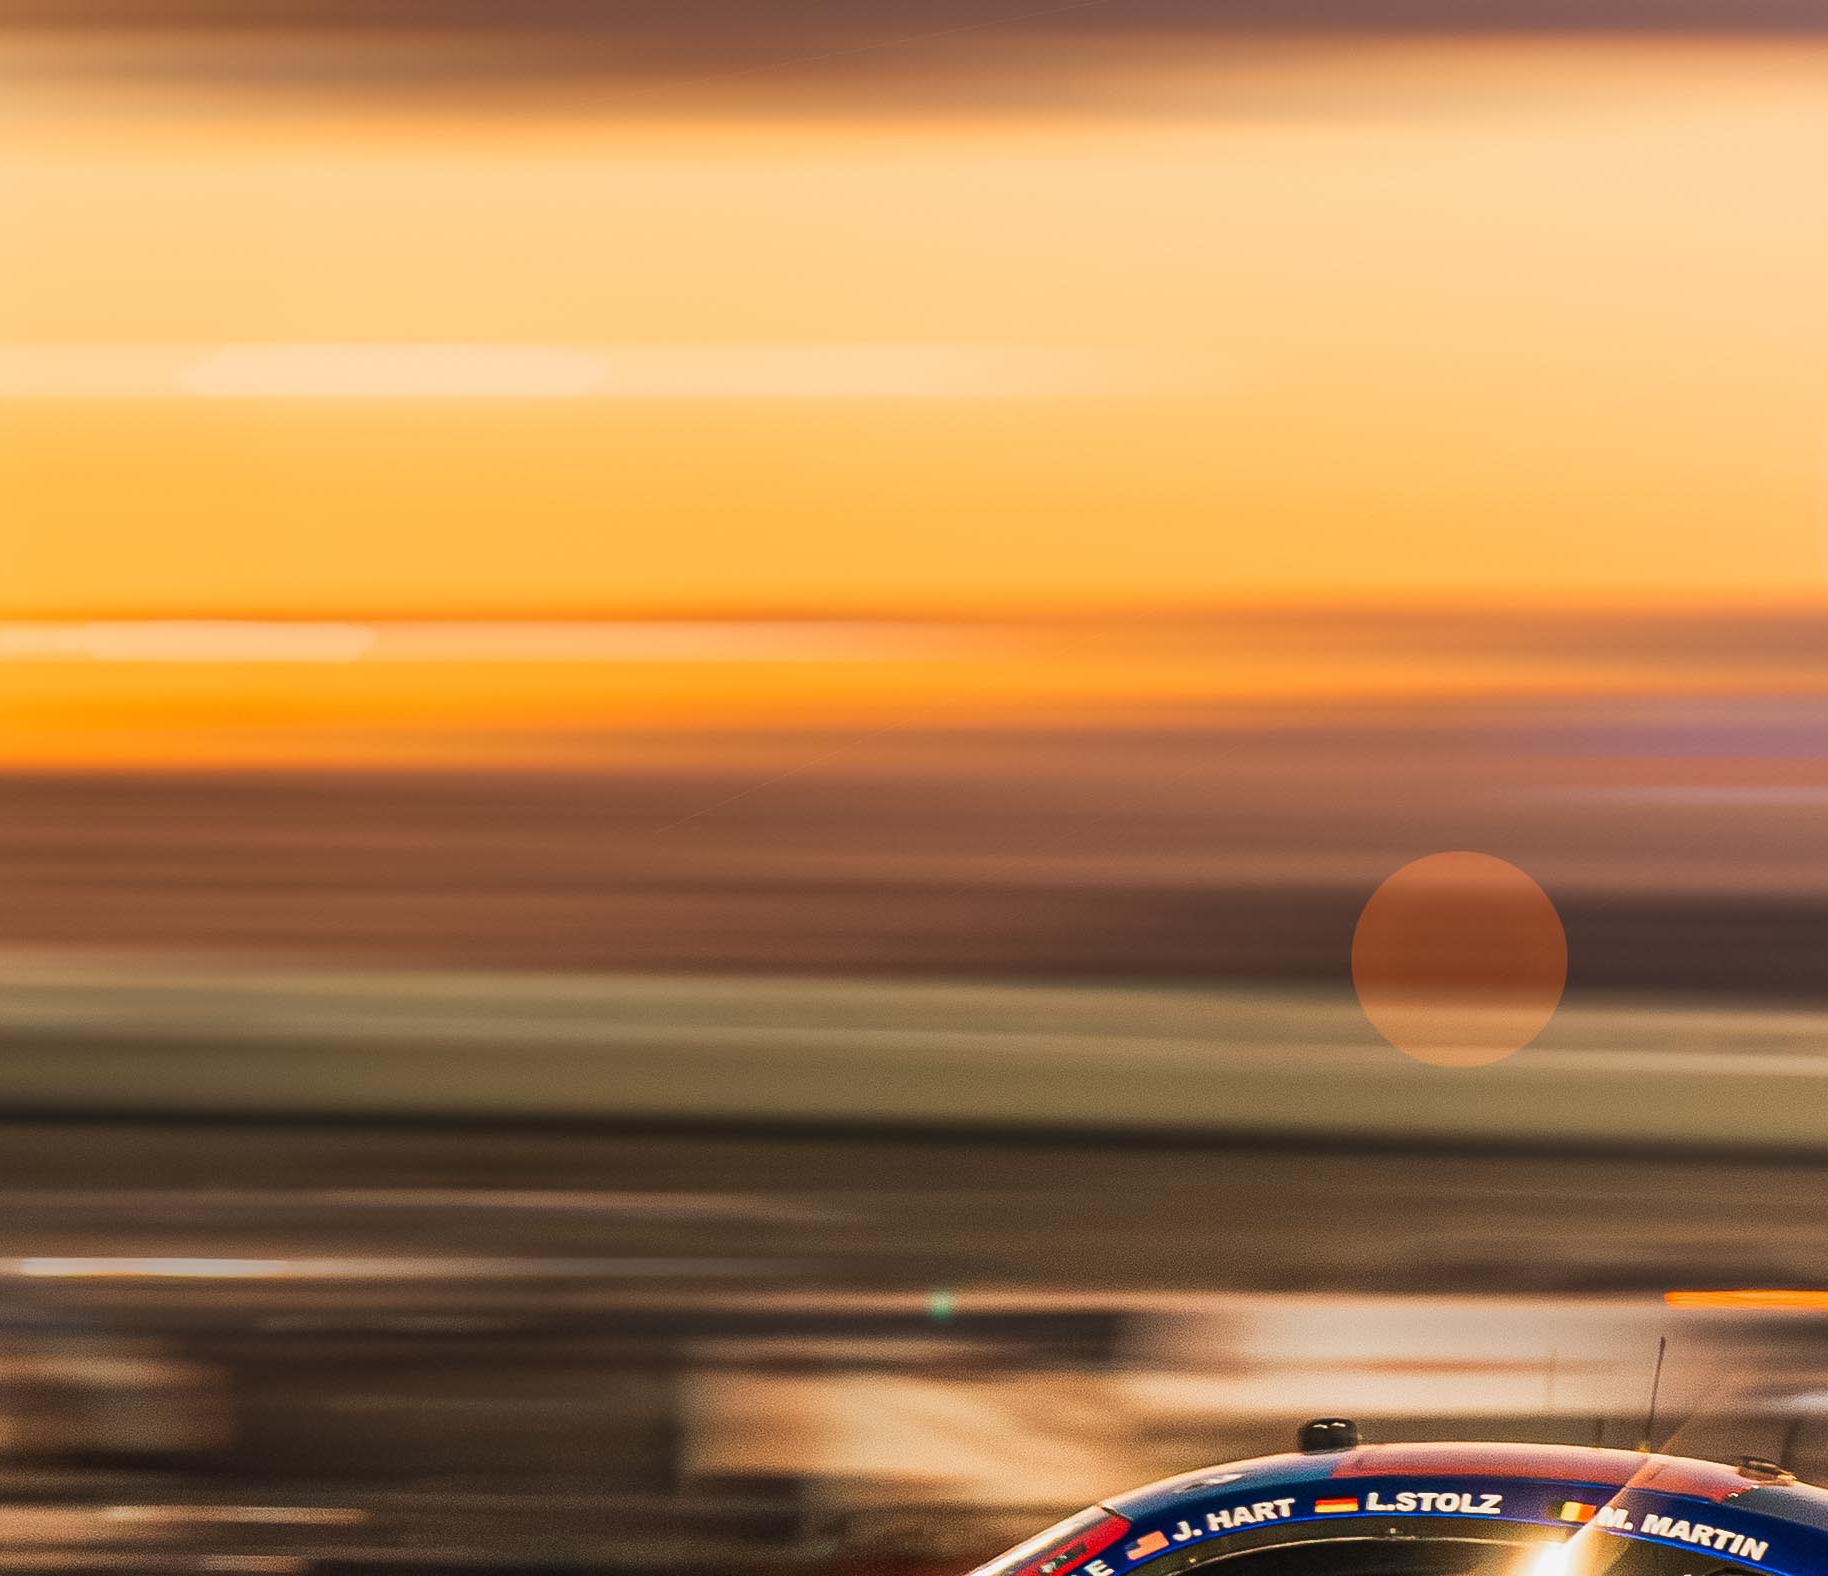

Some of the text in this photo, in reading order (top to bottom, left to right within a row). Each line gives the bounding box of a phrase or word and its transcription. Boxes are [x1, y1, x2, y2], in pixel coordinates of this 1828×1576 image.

[1172, 1497, 1296, 1543] J. HART
[1366, 1491, 1503, 1515] L.STOLZ
[1595, 1505, 1770, 1562] M. MARTIN
